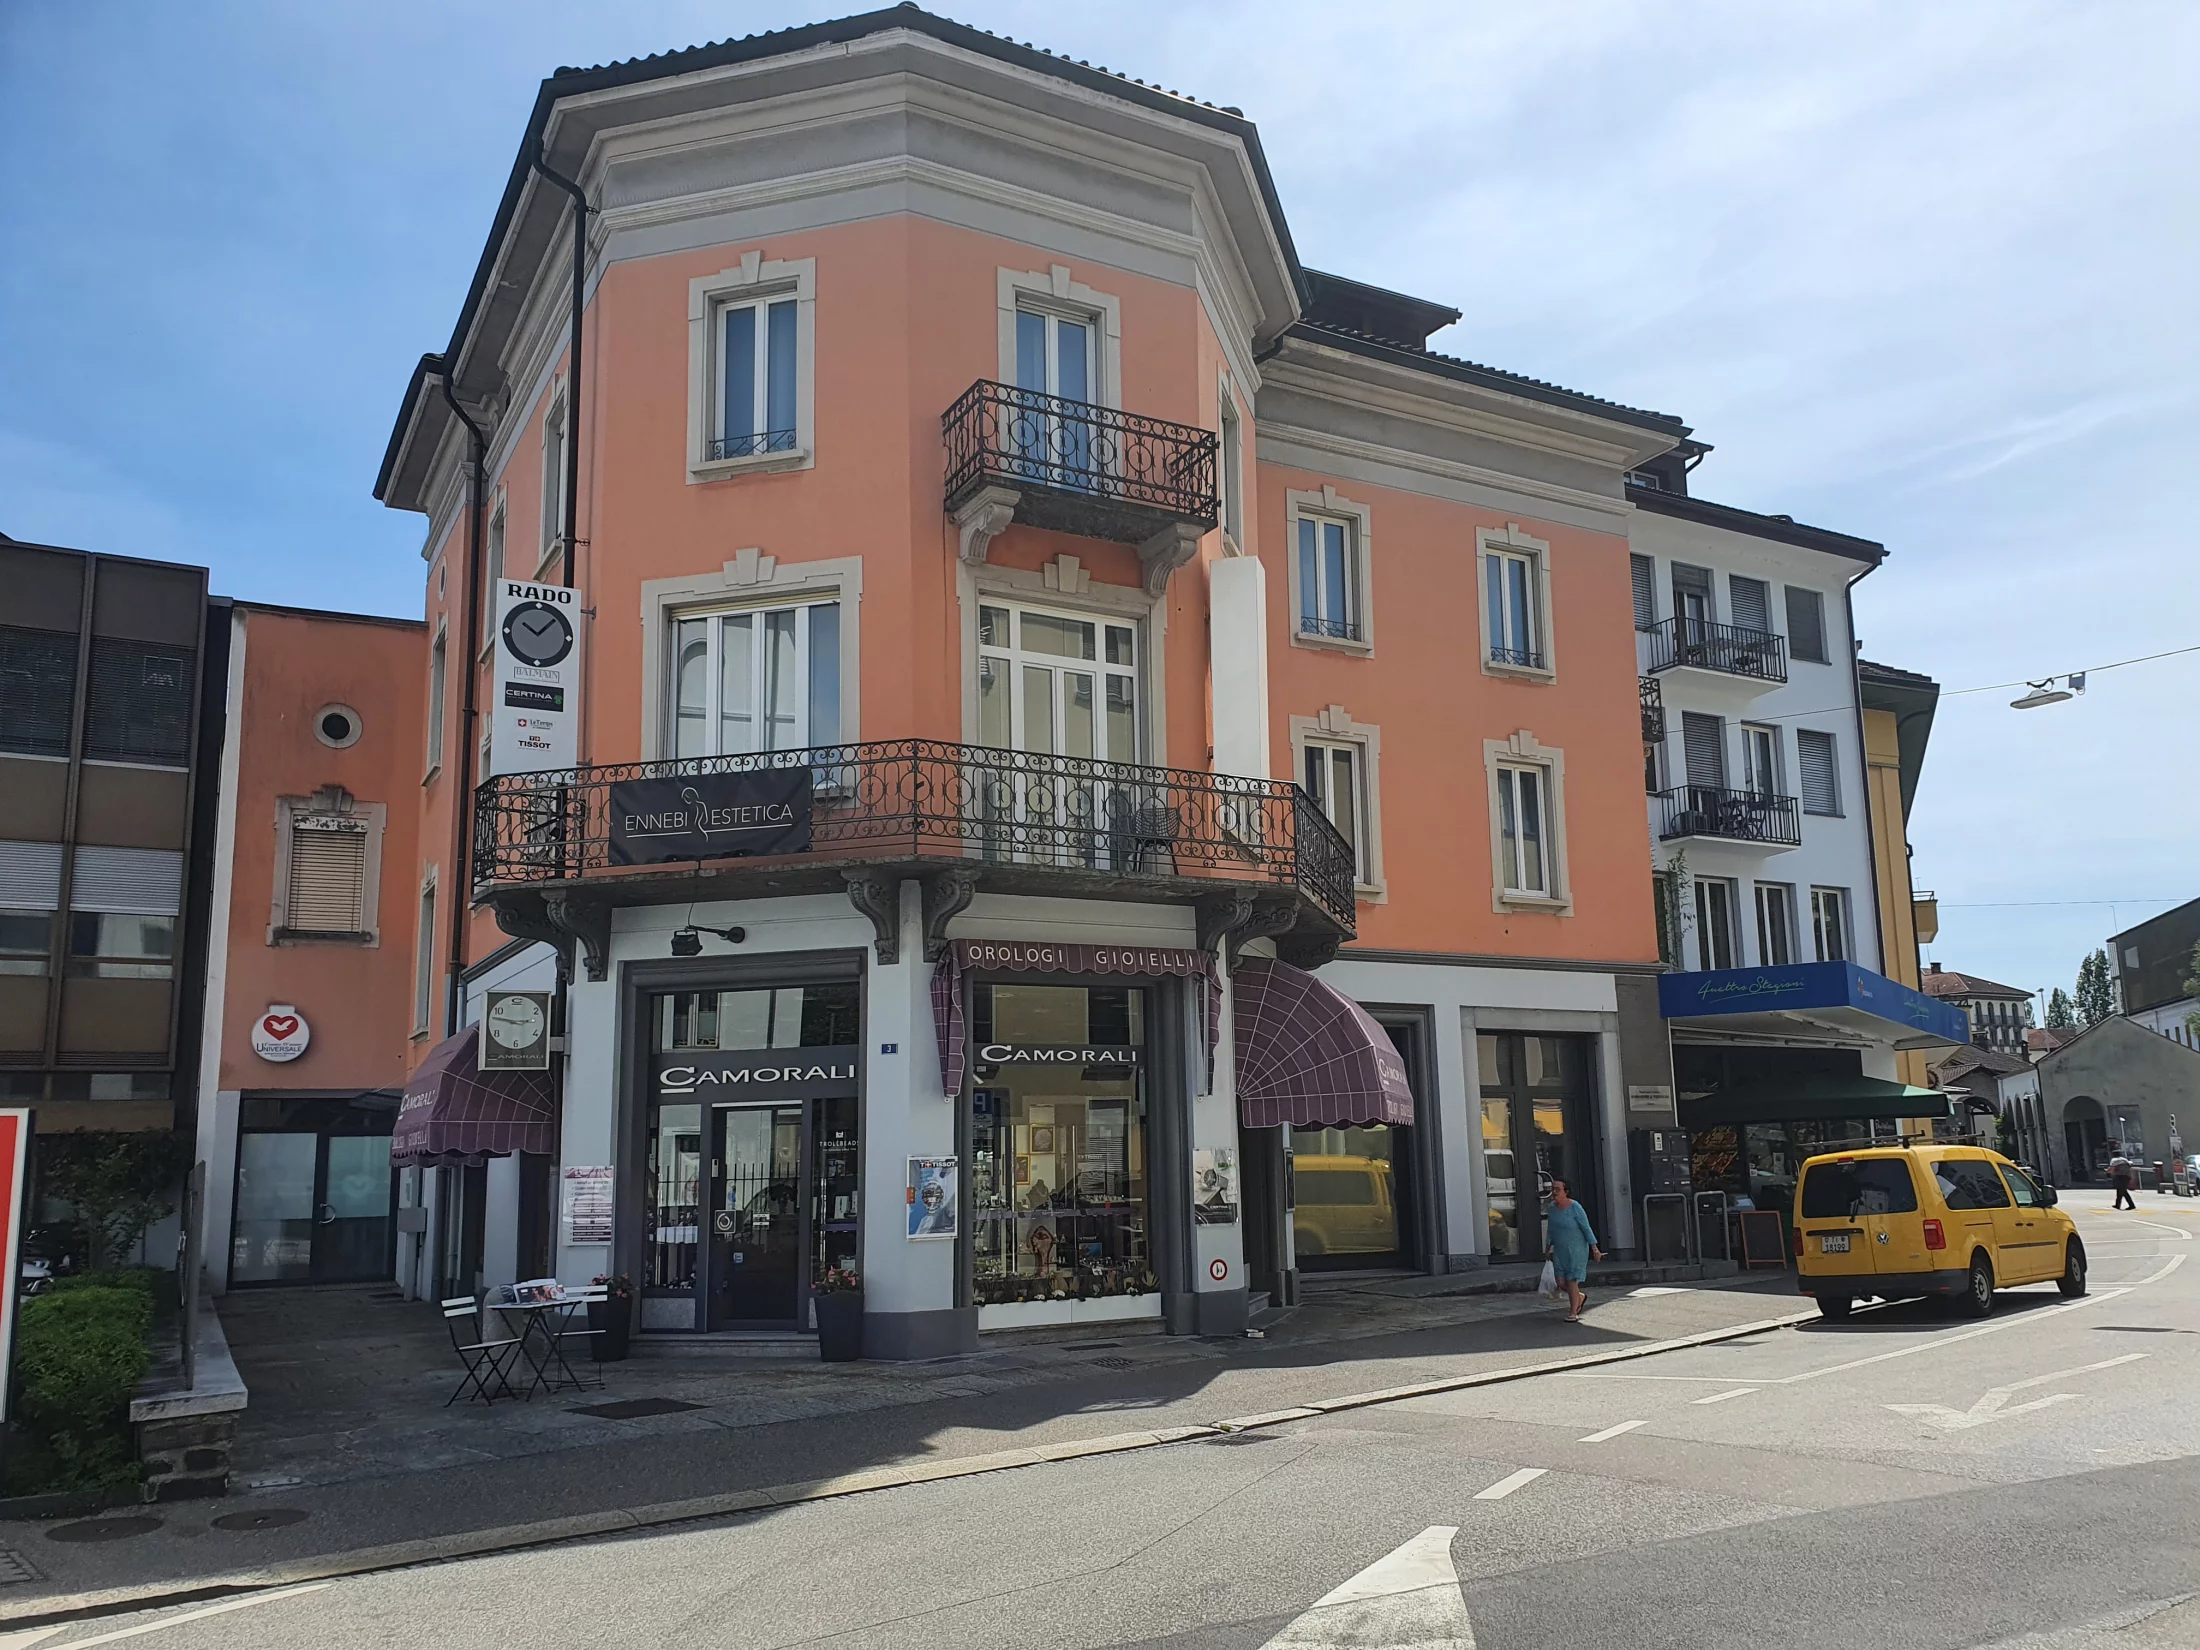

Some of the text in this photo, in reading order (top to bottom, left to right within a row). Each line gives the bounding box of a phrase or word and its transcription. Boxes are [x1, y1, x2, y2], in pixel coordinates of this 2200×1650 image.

[508, 584, 571, 604] RADO
[516, 668, 558, 679] BALMAIN
[506, 689, 553, 700] CERTINA
[518, 740, 551, 749] TISSOT
[625, 803, 794, 831] ENNEBI ESTETICA
[969, 946, 1194, 968] OROLOGI GIOIELLI
[1749, 976, 1805, 996] Stagioni
[494, 1007, 504, 1015] 10
[533, 1007, 539, 1015] 2
[493, 1030, 500, 1038] 8
[532, 1029, 539, 1037] 4
[513, 1040, 518, 1048] 6
[886, 1044, 892, 1053] 3
[981, 1045, 1137, 1062] CAMORALI
[660, 1064, 856, 1086] CAMORALI
